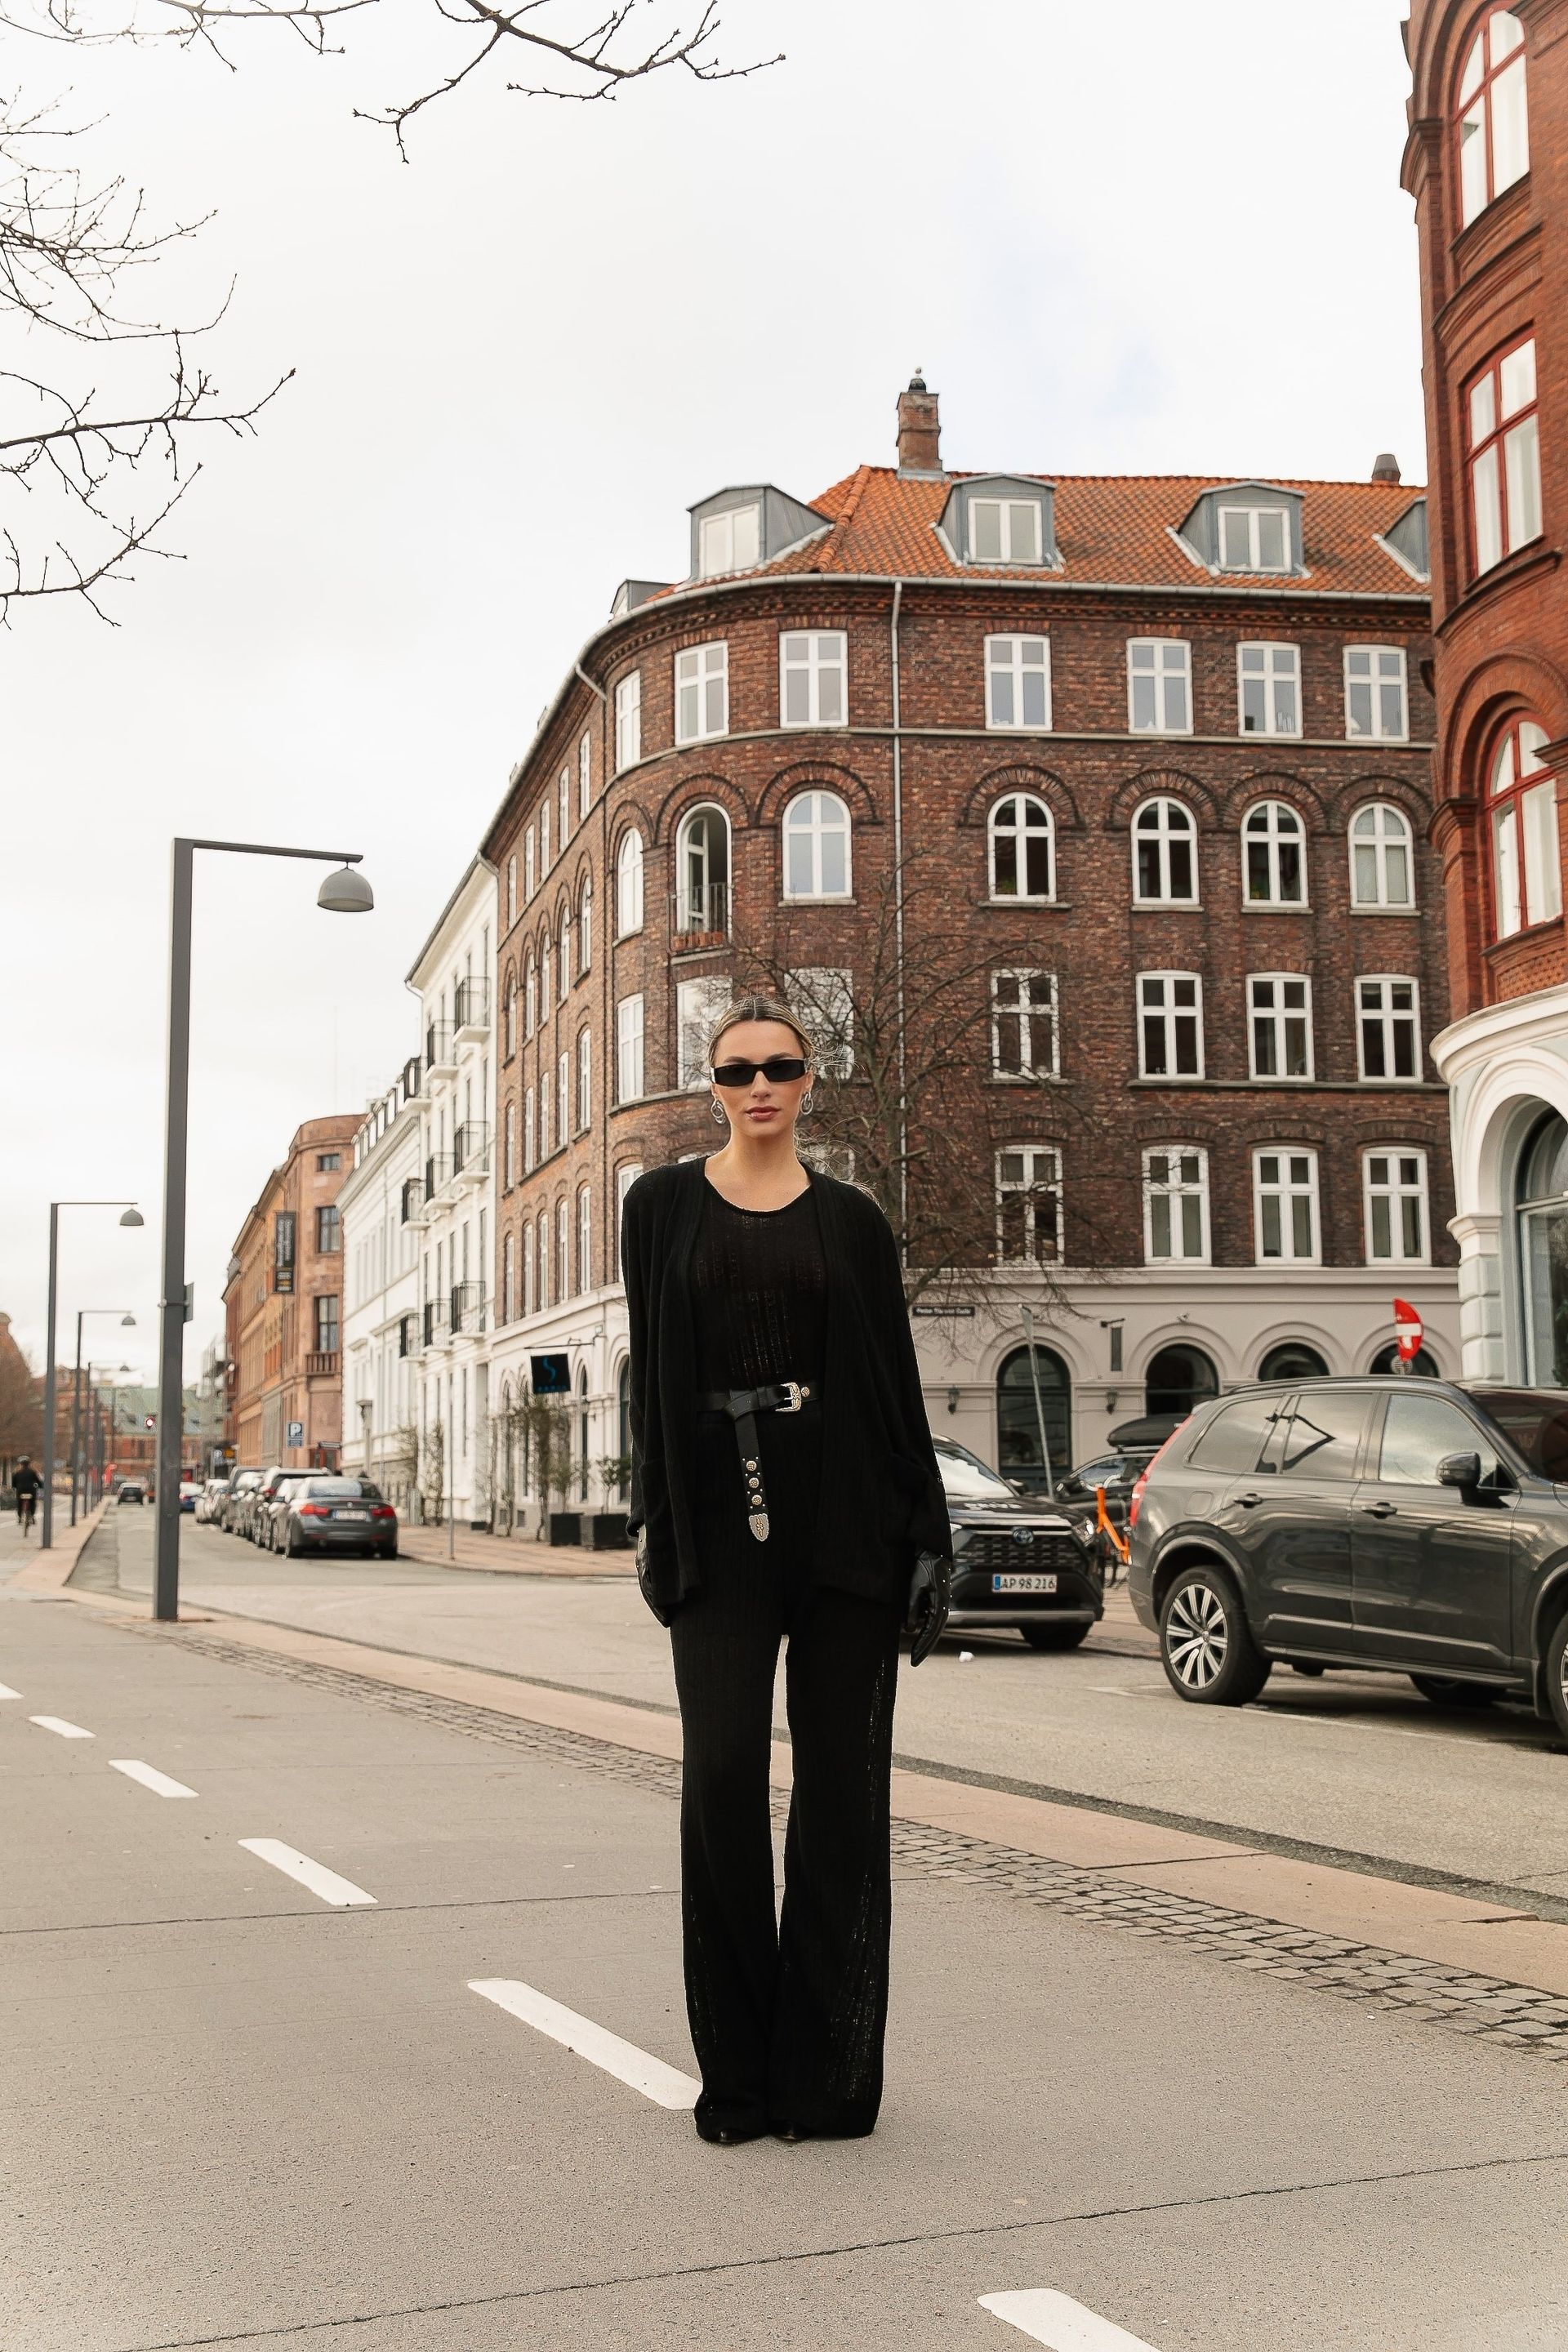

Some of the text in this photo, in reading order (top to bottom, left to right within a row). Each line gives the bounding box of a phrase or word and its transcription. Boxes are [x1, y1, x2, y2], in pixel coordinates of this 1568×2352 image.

[1001, 1577, 1055, 1589] AP 98 216
